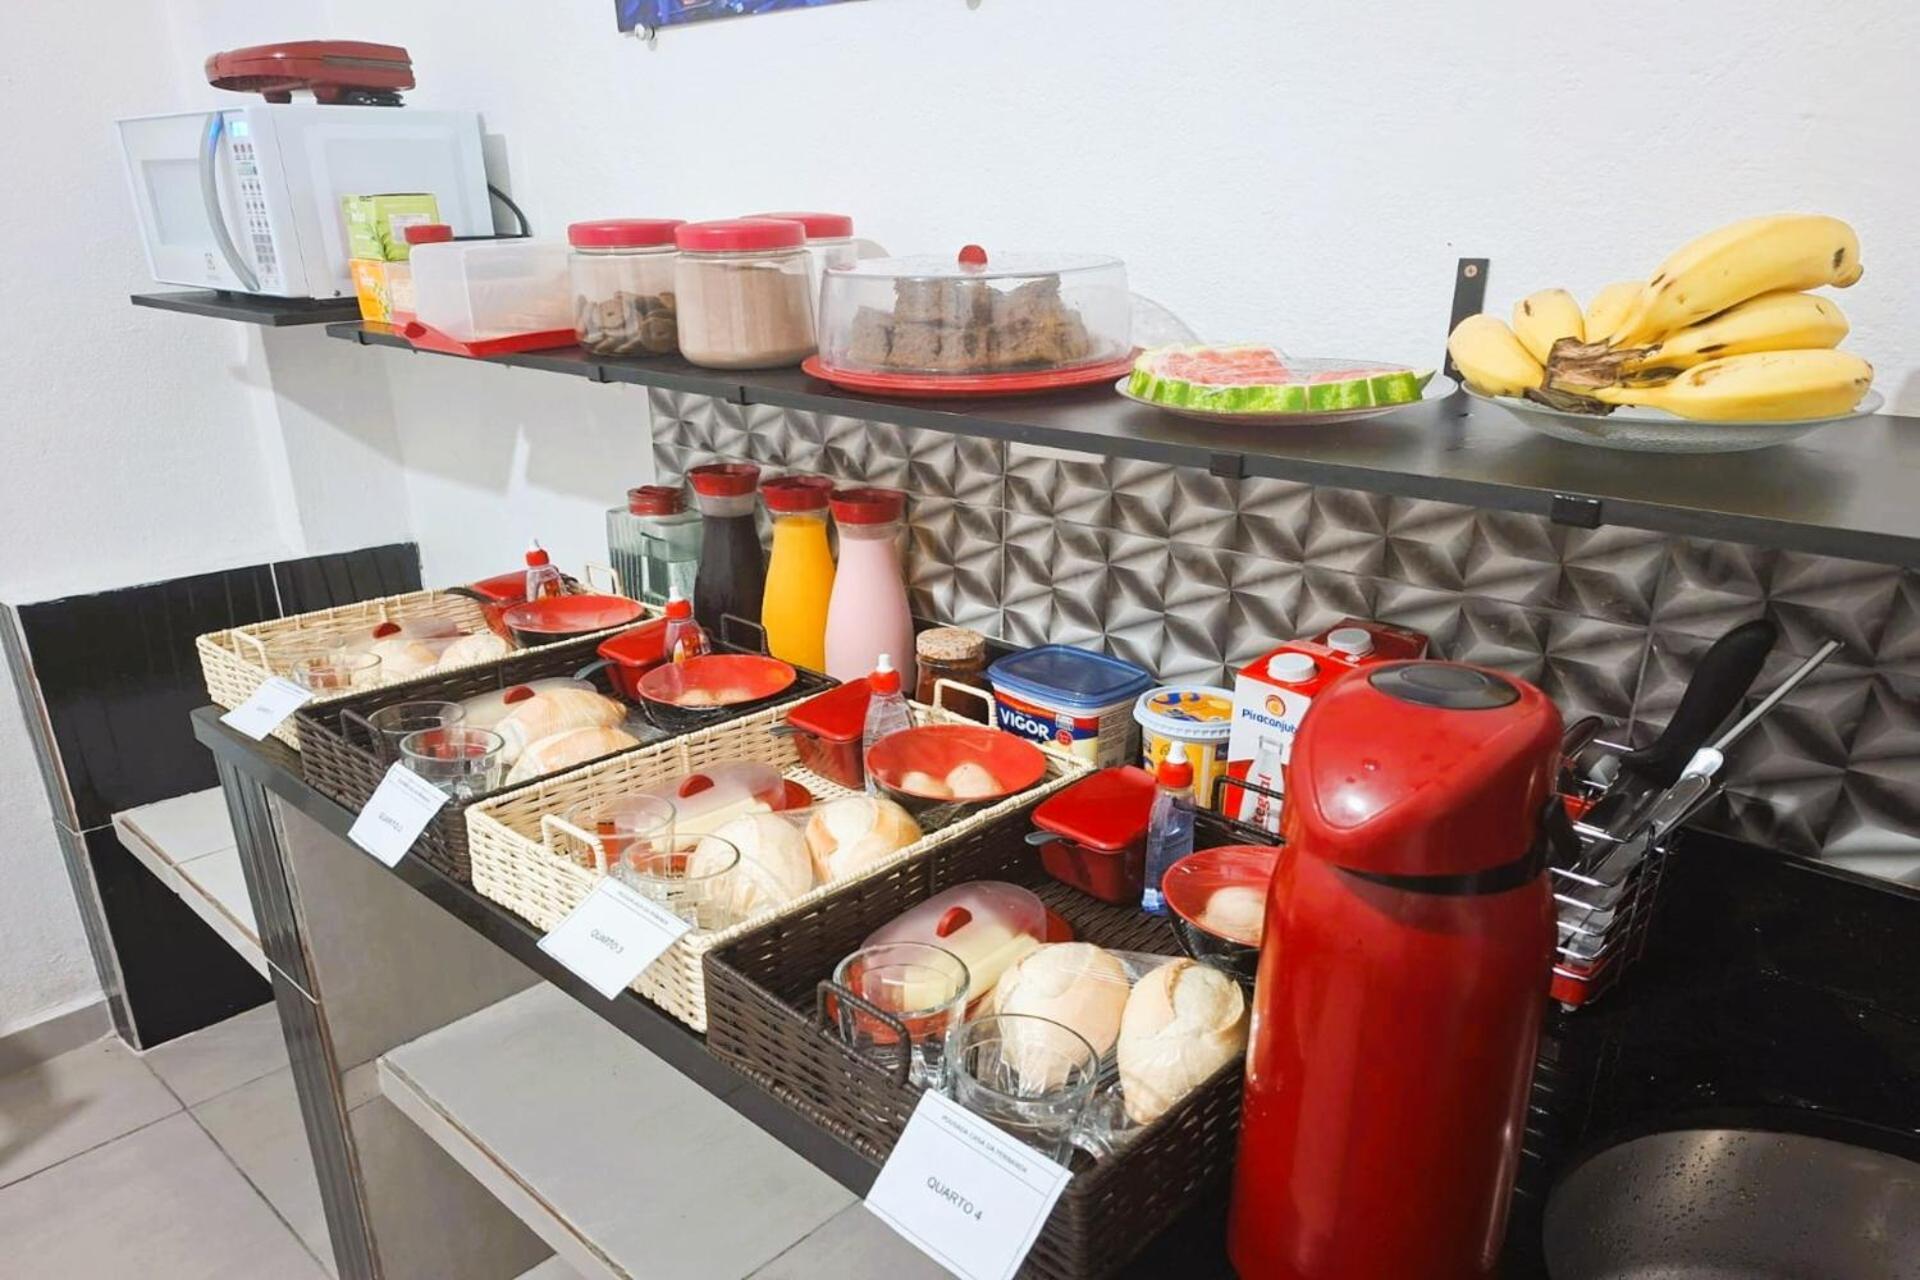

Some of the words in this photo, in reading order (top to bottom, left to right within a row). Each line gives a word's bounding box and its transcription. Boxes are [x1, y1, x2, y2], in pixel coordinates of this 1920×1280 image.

[1000, 707, 1050, 741] VIGOR
[1242, 708, 1298, 733] Piracanjub
[590, 928, 618, 950] QUARTO
[927, 1176, 974, 1214] QUARTO
[974, 1210, 983, 1221] 4
